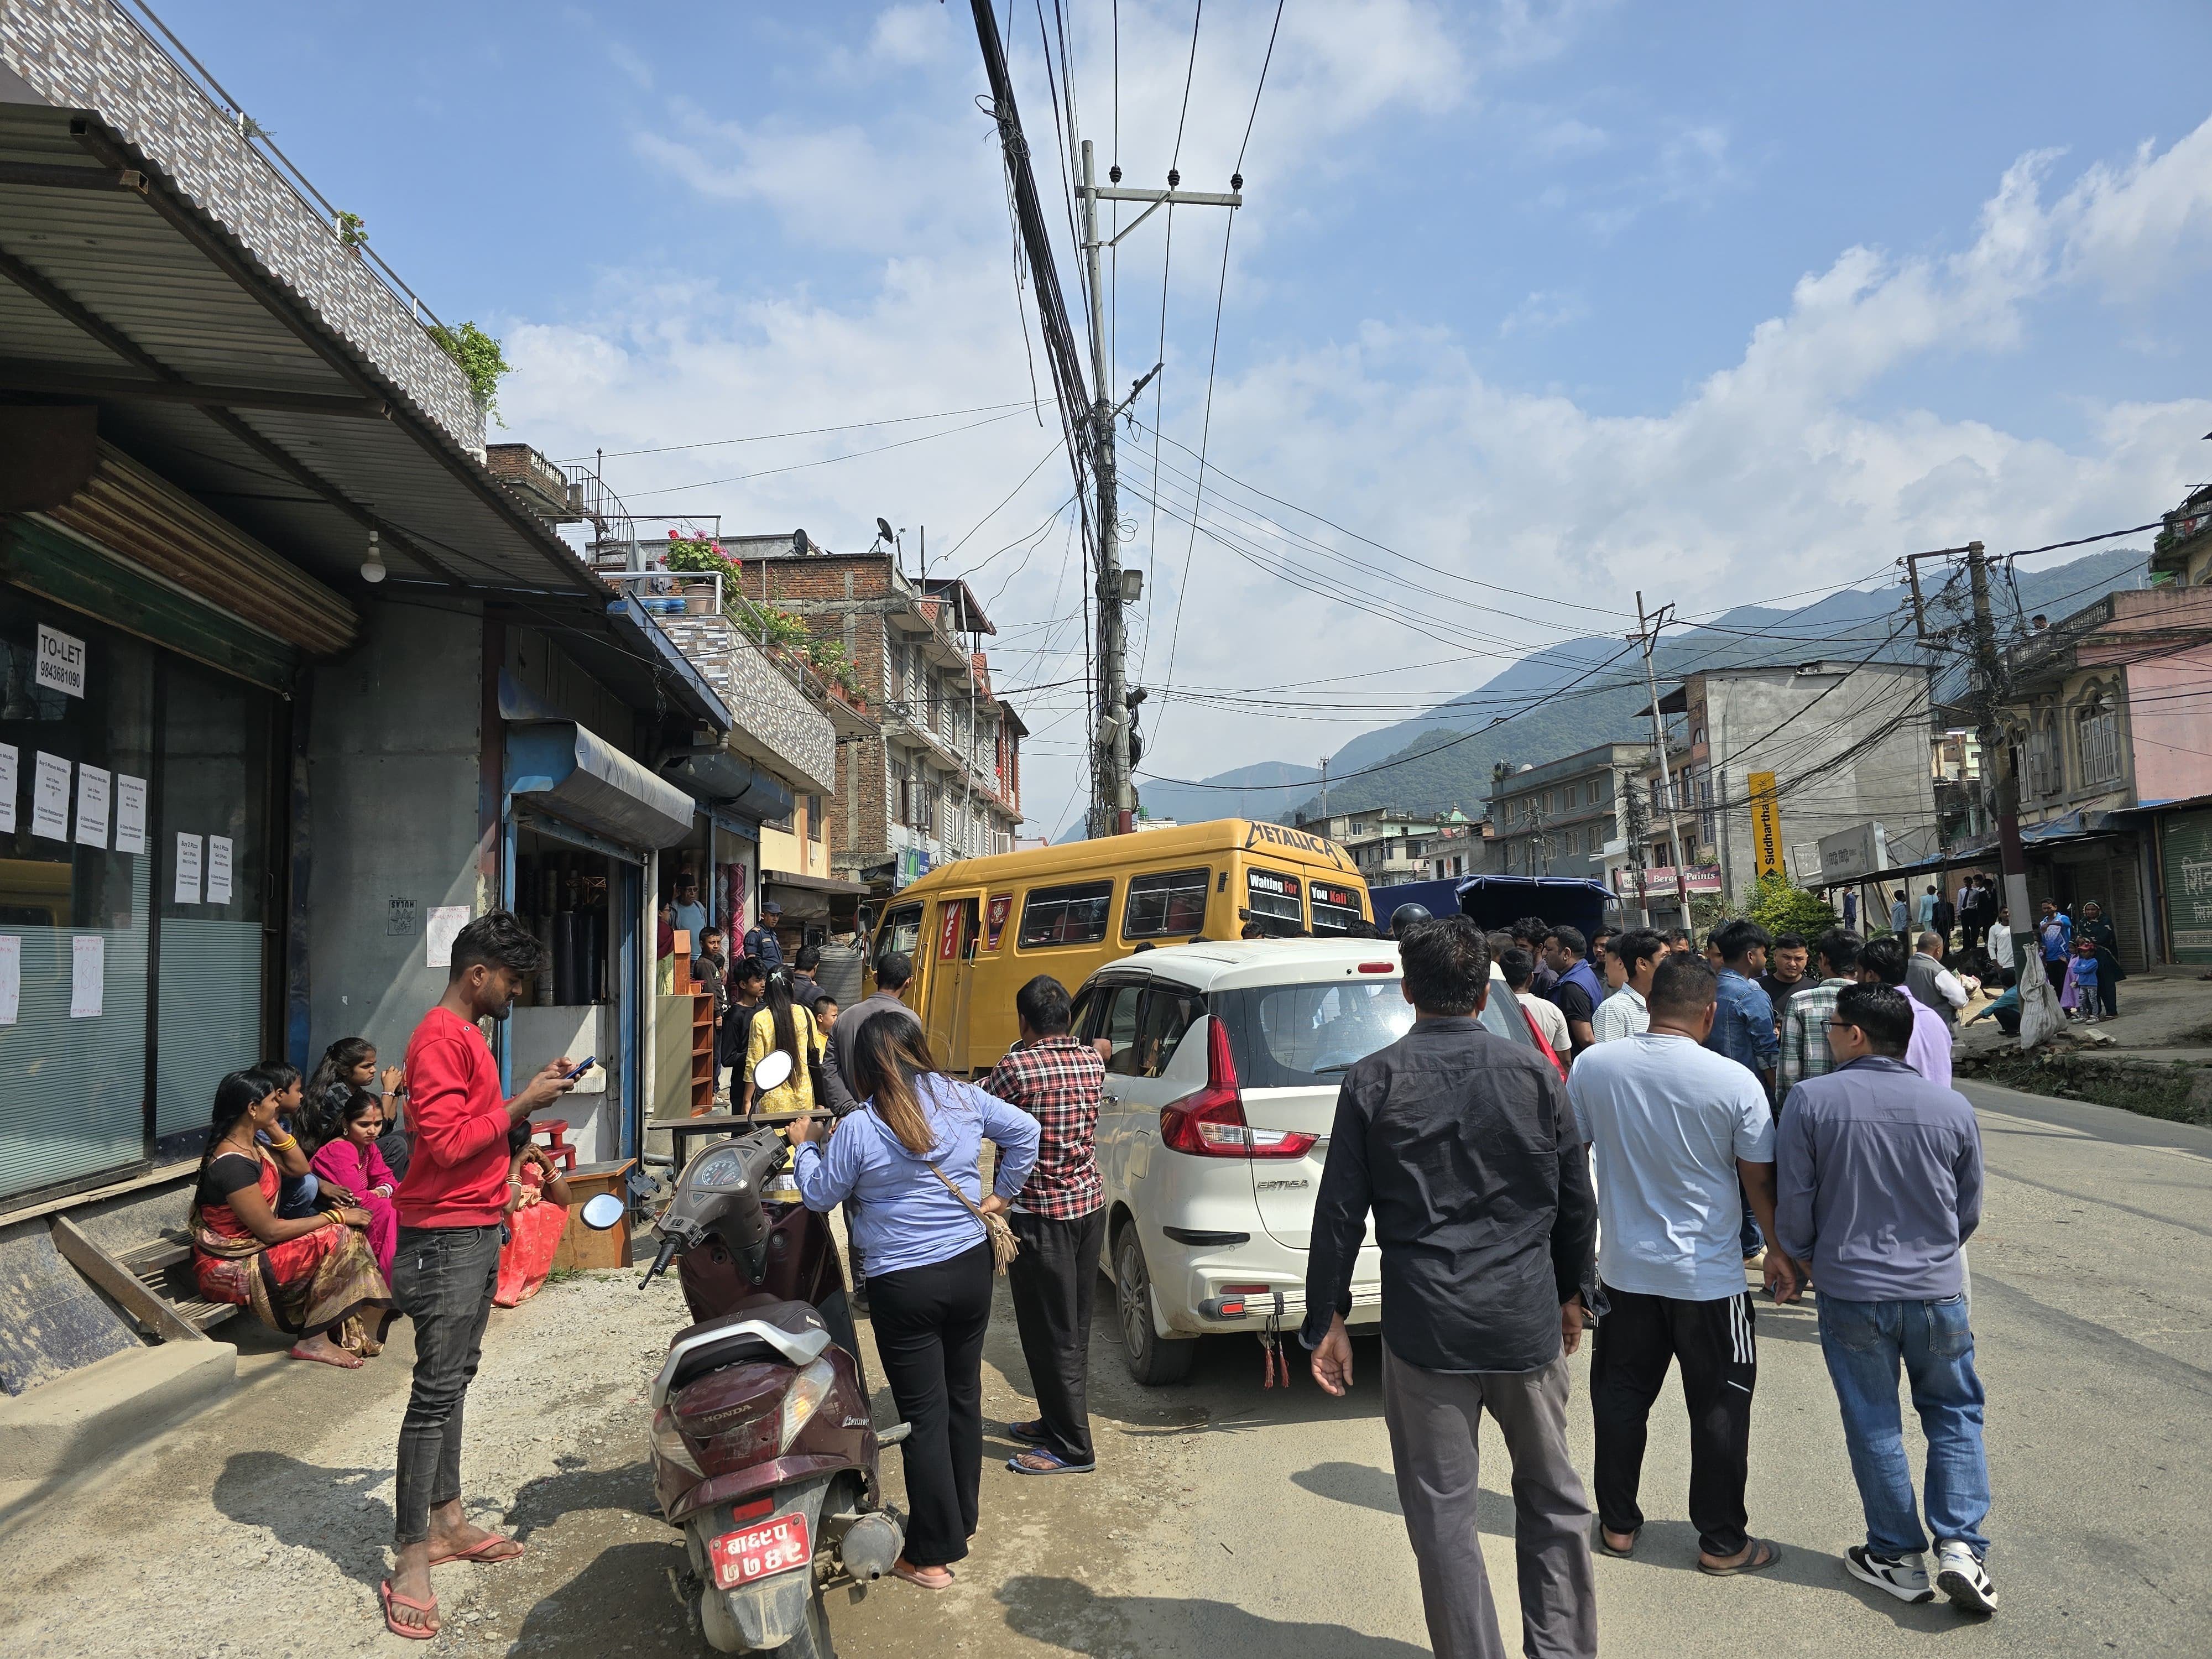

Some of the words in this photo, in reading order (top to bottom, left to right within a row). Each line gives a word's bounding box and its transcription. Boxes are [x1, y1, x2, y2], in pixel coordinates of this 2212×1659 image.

[41, 634, 81, 665] TO-LET
[41, 661, 80, 688] 9843681090
[1757, 779, 1769, 803] Bnk
[1760, 803, 1775, 865] Siddhartha
[1245, 821, 1343, 870] METALLICA
[1250, 874, 1284, 893] Waiting
[1284, 880, 1297, 894] For
[1653, 875, 1678, 884] Berge
[1686, 871, 1715, 880] Paints
[1311, 886, 1328, 900] You
[1329, 890, 1347, 905] Kali
[1256, 1179, 1310, 1190] ERTIGA
[702, 1405, 753, 1423] HONDA
